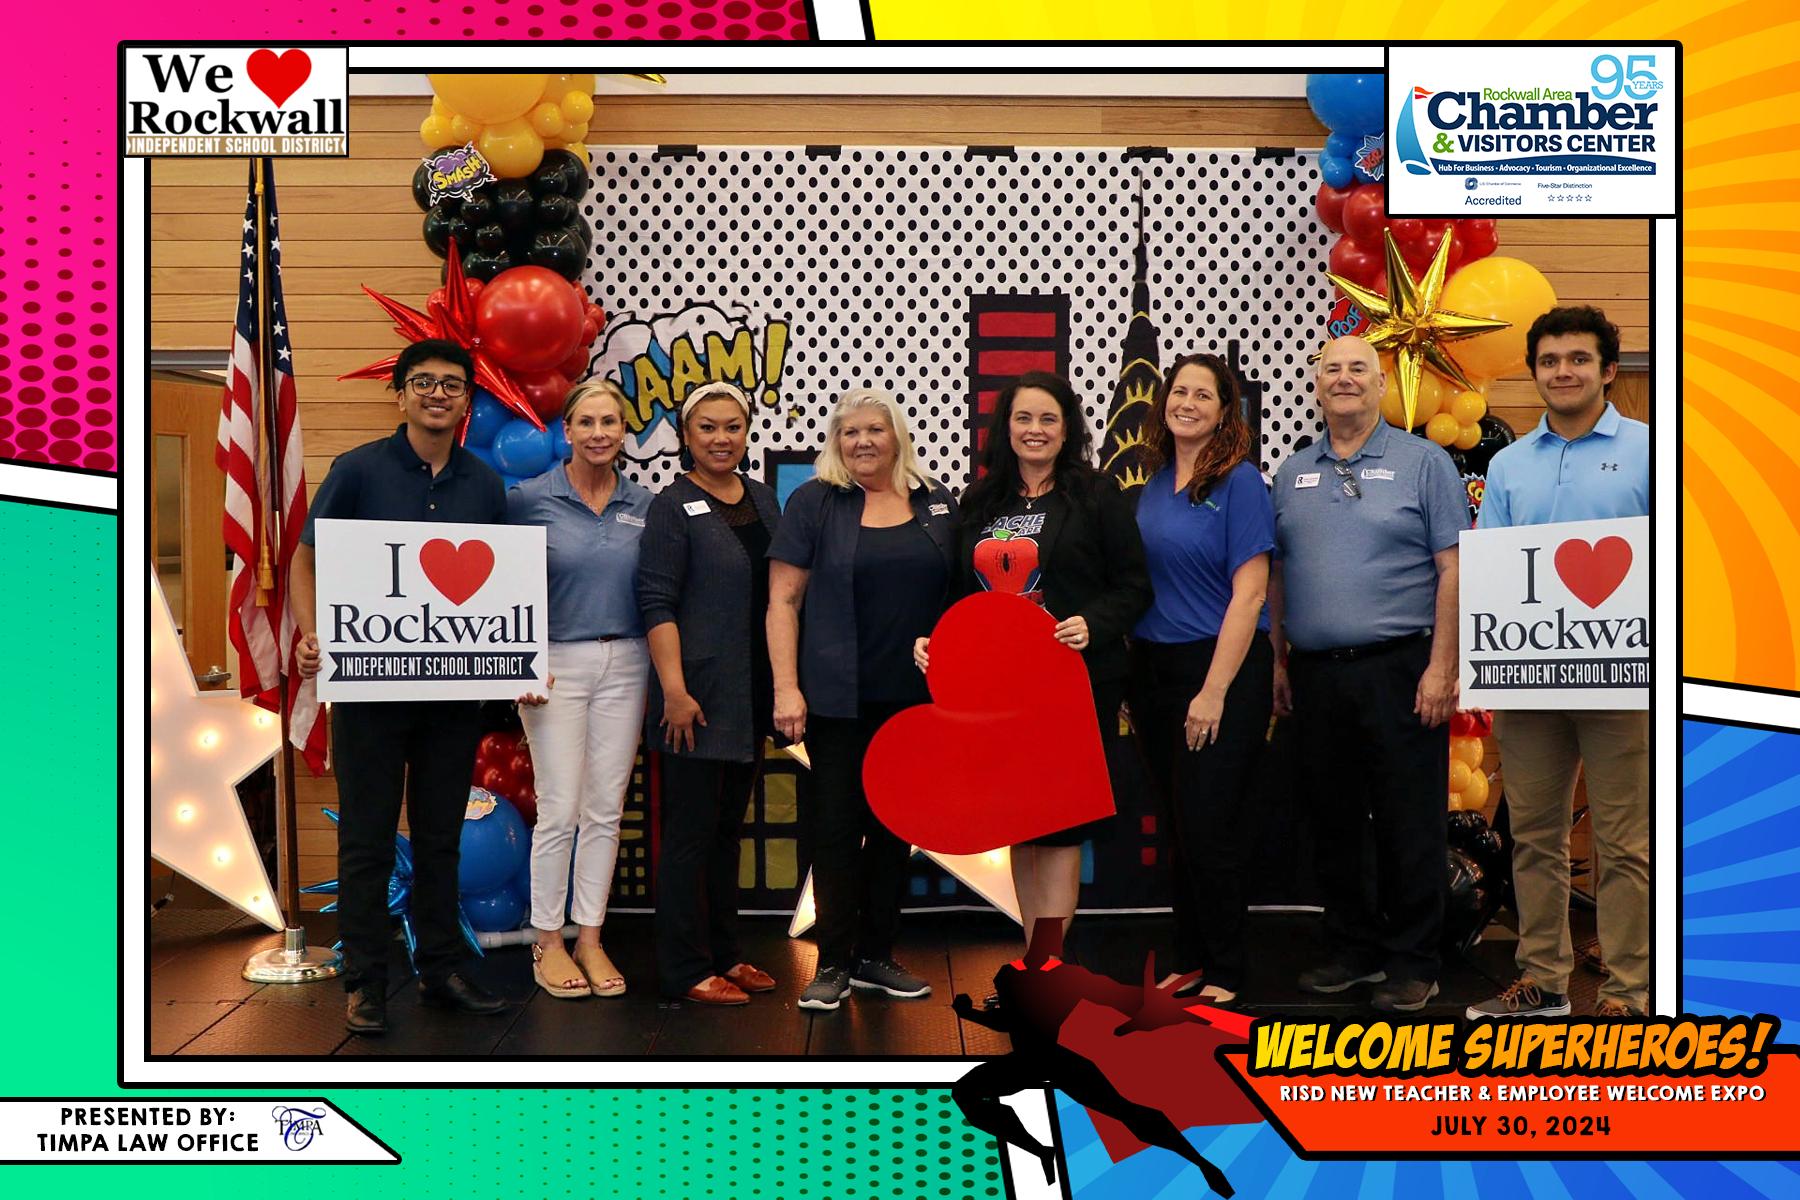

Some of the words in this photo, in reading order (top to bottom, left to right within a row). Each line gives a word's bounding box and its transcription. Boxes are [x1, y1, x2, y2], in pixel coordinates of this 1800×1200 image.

[620, 318, 790, 433] AAM!
[384, 542, 407, 598] I
[1520, 547, 1542, 605] I
[329, 602, 537, 645] Rockwall
[1470, 607, 1649, 652] Rockwa
[341, 656, 422, 677] INDEPENDENT
[425, 656, 471, 676] SCHOOL
[474, 656, 524, 676] DISTRICT
[1480, 664, 1556, 685] INDEPENDENT
[1560, 663, 1607, 684] SCHOOL
[1611, 662, 1649, 684] DISTRI
